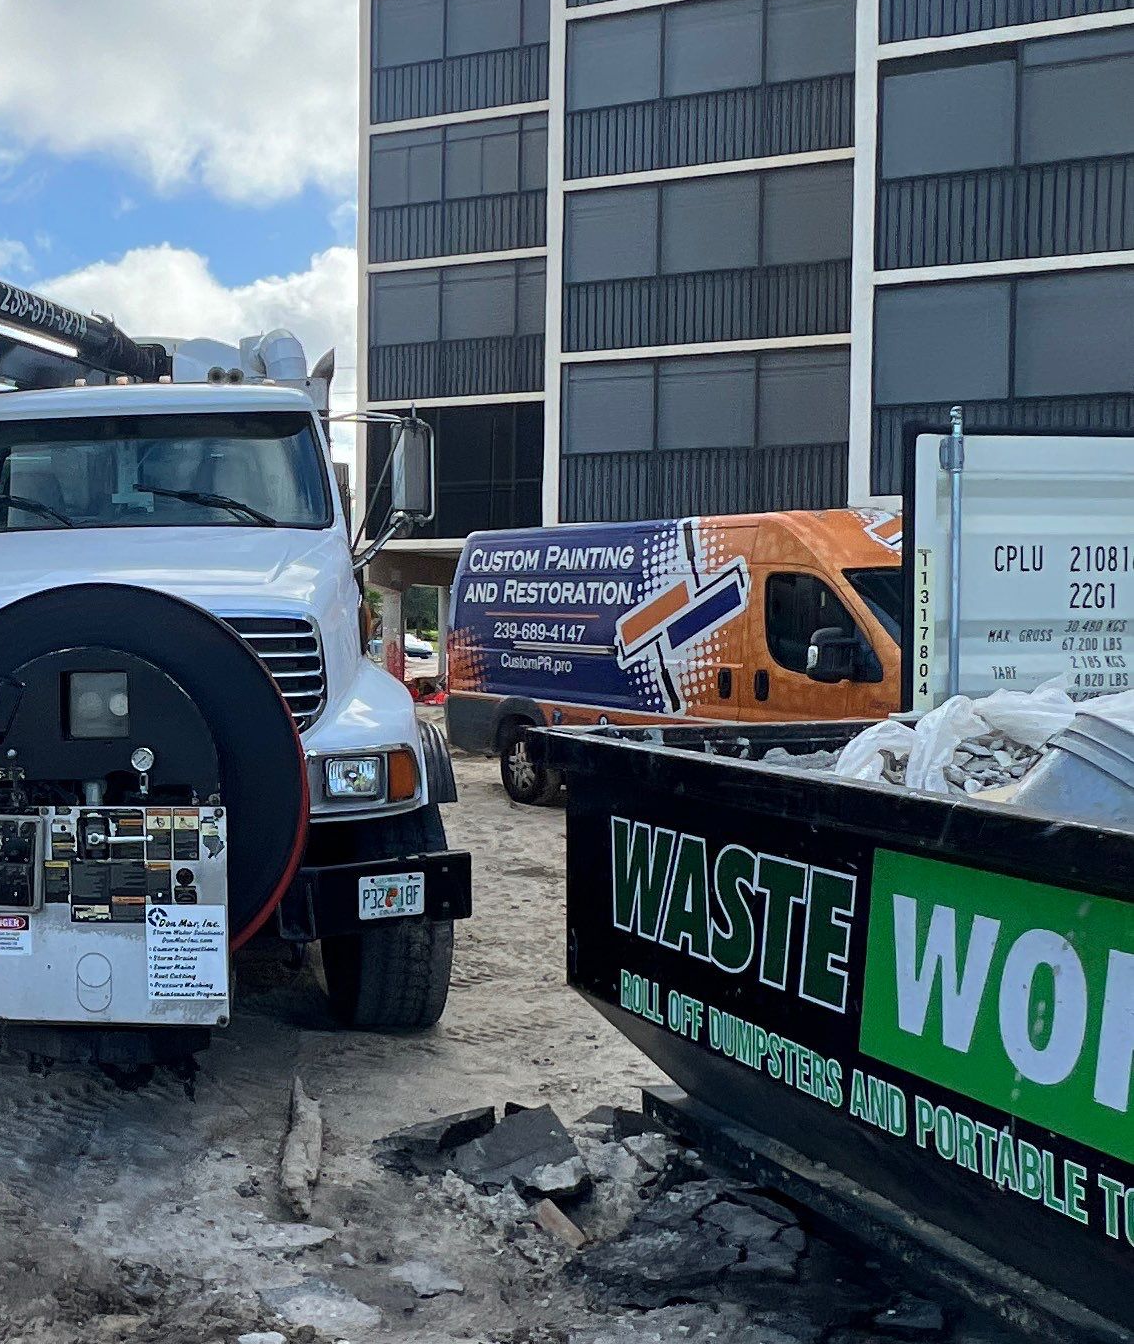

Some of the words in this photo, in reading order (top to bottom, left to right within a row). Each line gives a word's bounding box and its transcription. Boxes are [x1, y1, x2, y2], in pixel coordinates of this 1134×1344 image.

[469, 548, 540, 572] CUSTOM
[544, 545, 635, 570] PAINTING
[994, 545, 1044, 572] CPLU
[1069, 545, 1134, 572] 21081
[463, 582, 498, 603] AND
[1069, 582, 1116, 609] 22G1
[493, 621, 586, 643] 239-689-4147
[500, 652, 573, 675] CustomPR.pro
[610, 815, 858, 1014] WASTE
[620, 968, 664, 1026] ROLL
[667, 989, 705, 1042] OFF
[708, 1005, 844, 1108] DUMPSTERS
[849, 1068, 907, 1138] AND
[914, 1094, 1089, 1226] PORTABLE
